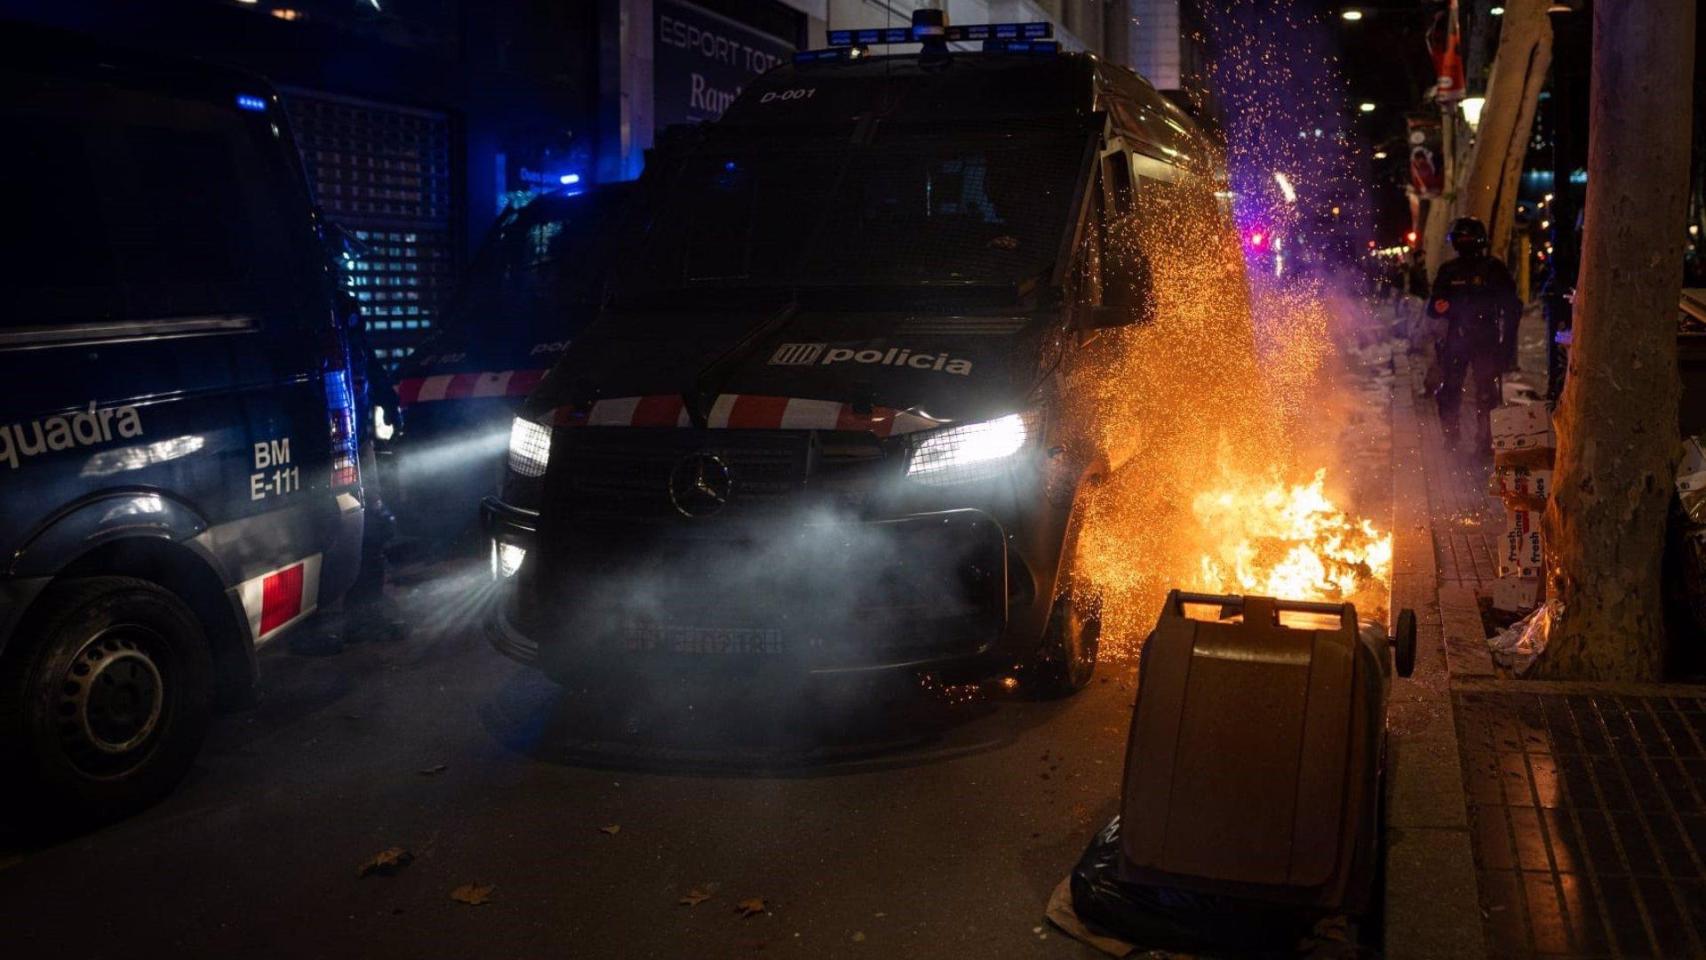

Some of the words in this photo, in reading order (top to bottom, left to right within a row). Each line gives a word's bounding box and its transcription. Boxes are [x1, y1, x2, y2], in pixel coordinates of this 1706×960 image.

[660, 15, 740, 65] ESPORT
[743, 46, 783, 75] TOT
[690, 72, 742, 113] Ram
[760, 88, 816, 103] D-001
[821, 347, 974, 376] policia
[0, 400, 144, 469] quadra
[254, 438, 291, 469] BM
[251, 467, 300, 500] E-111
[1507, 531, 1517, 561] fresh
[1529, 531, 1540, 562] fresh
